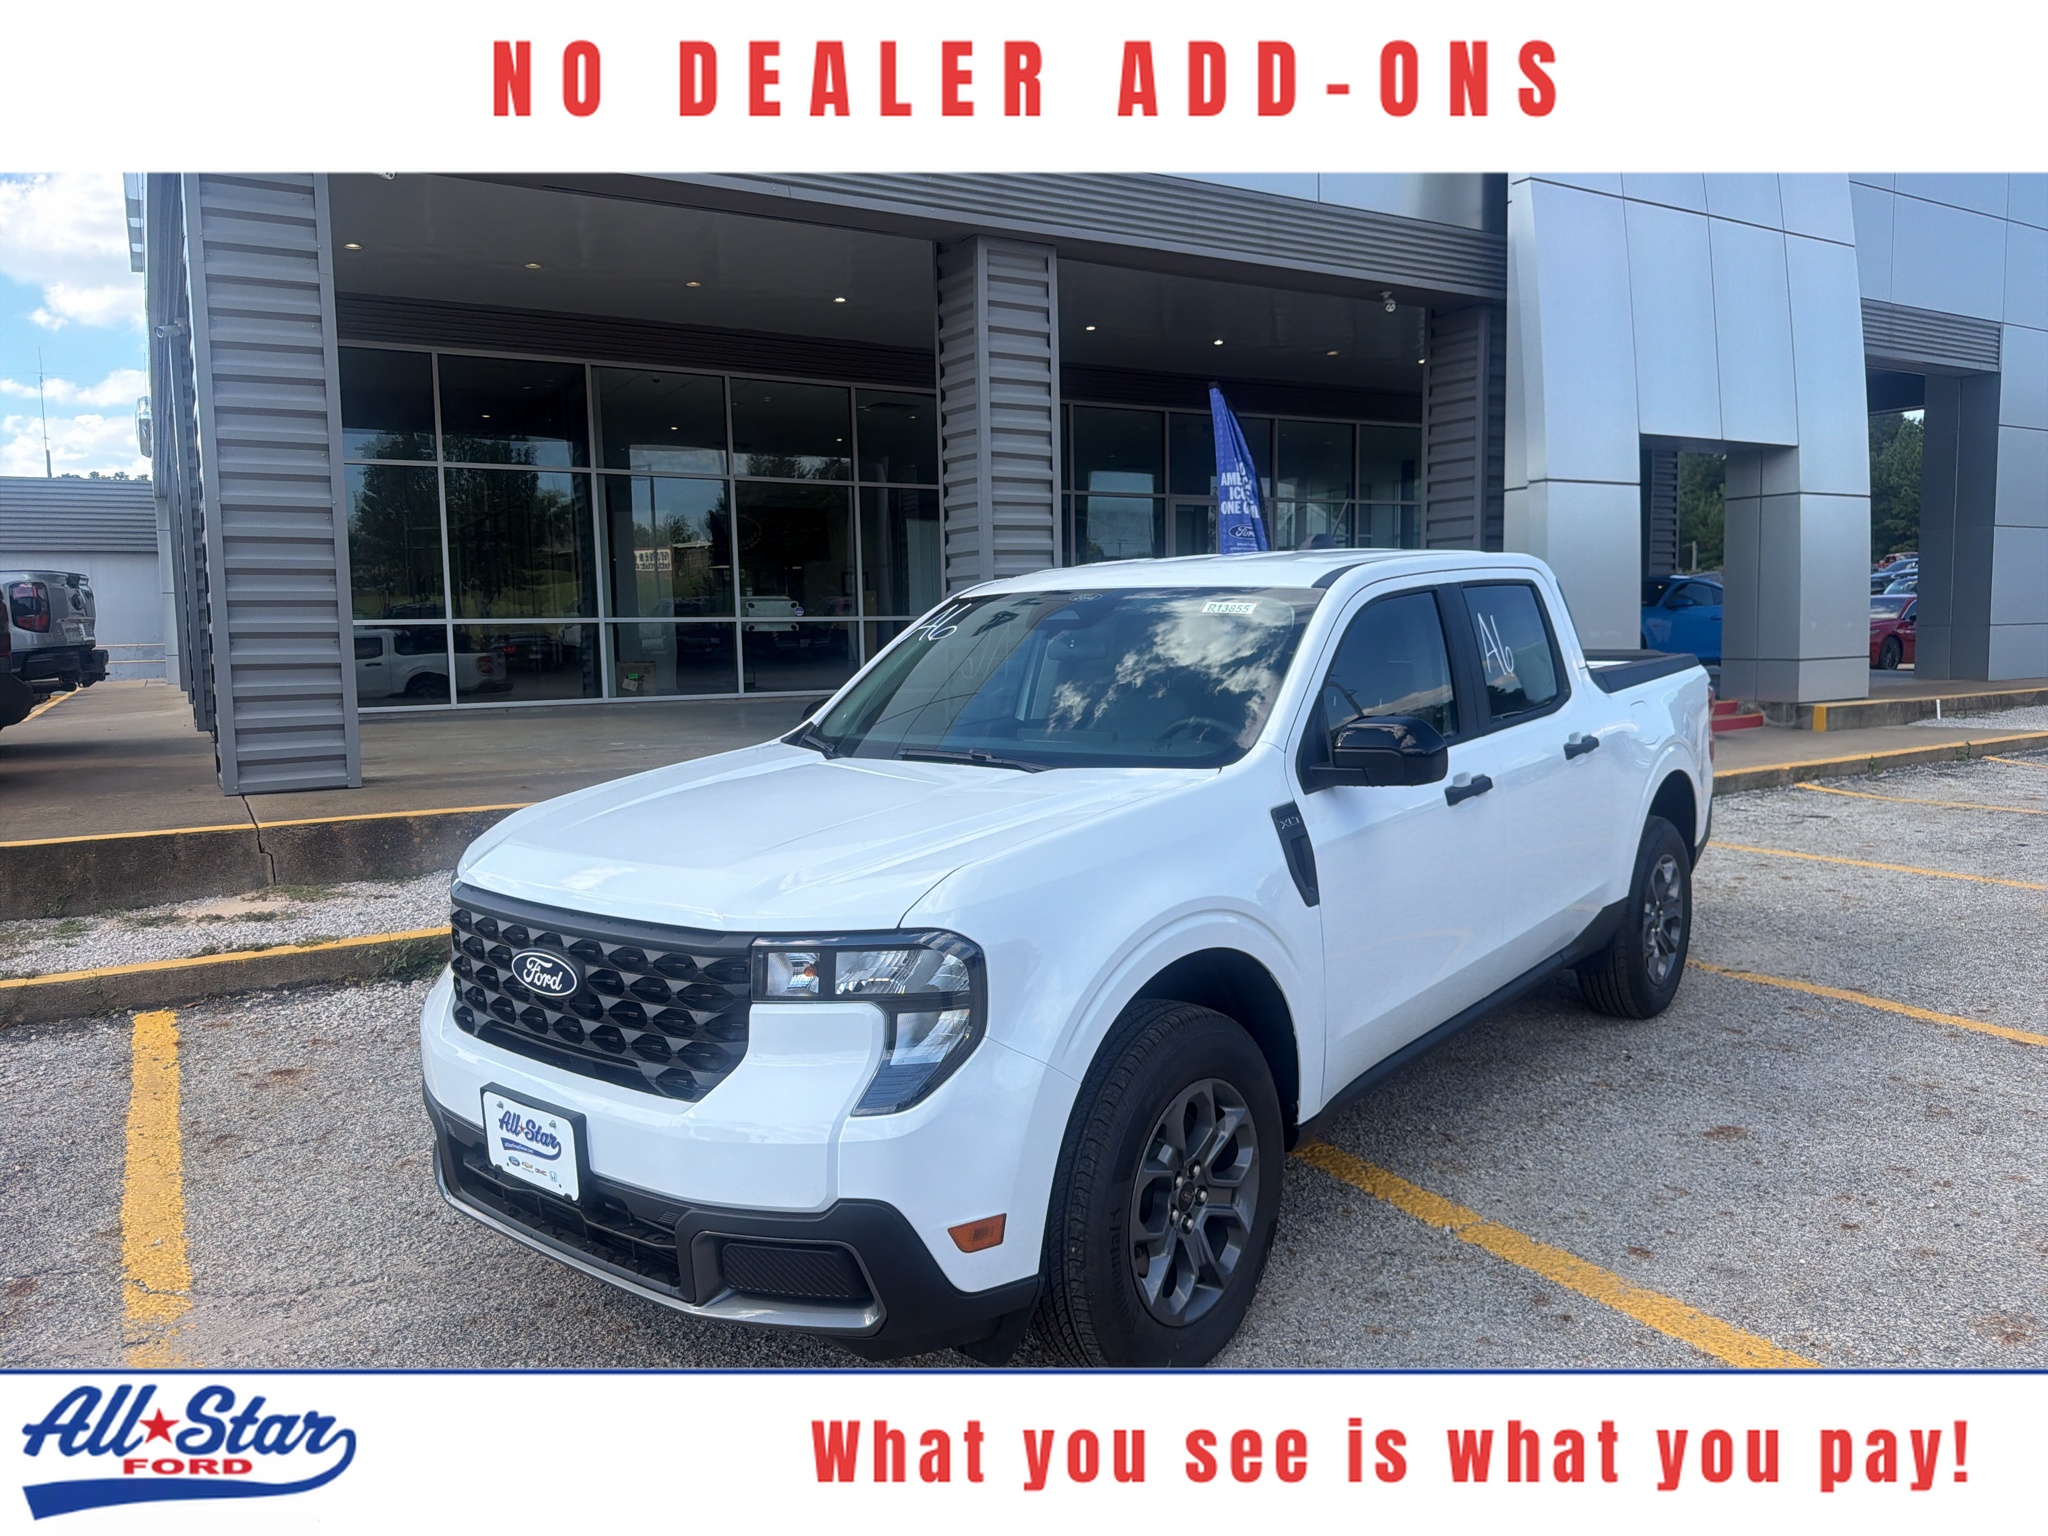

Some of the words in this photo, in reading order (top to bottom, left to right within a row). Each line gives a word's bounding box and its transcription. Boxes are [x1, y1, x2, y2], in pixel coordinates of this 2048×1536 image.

[1221, 500, 1241, 515] ONE
[901, 603, 972, 643] A6
[1477, 613, 1515, 676] A6
[1279, 816, 1300, 830] XLT
[522, 956, 564, 991] Ford
[498, 1110, 521, 1137] All
[524, 1119, 560, 1150] Star
